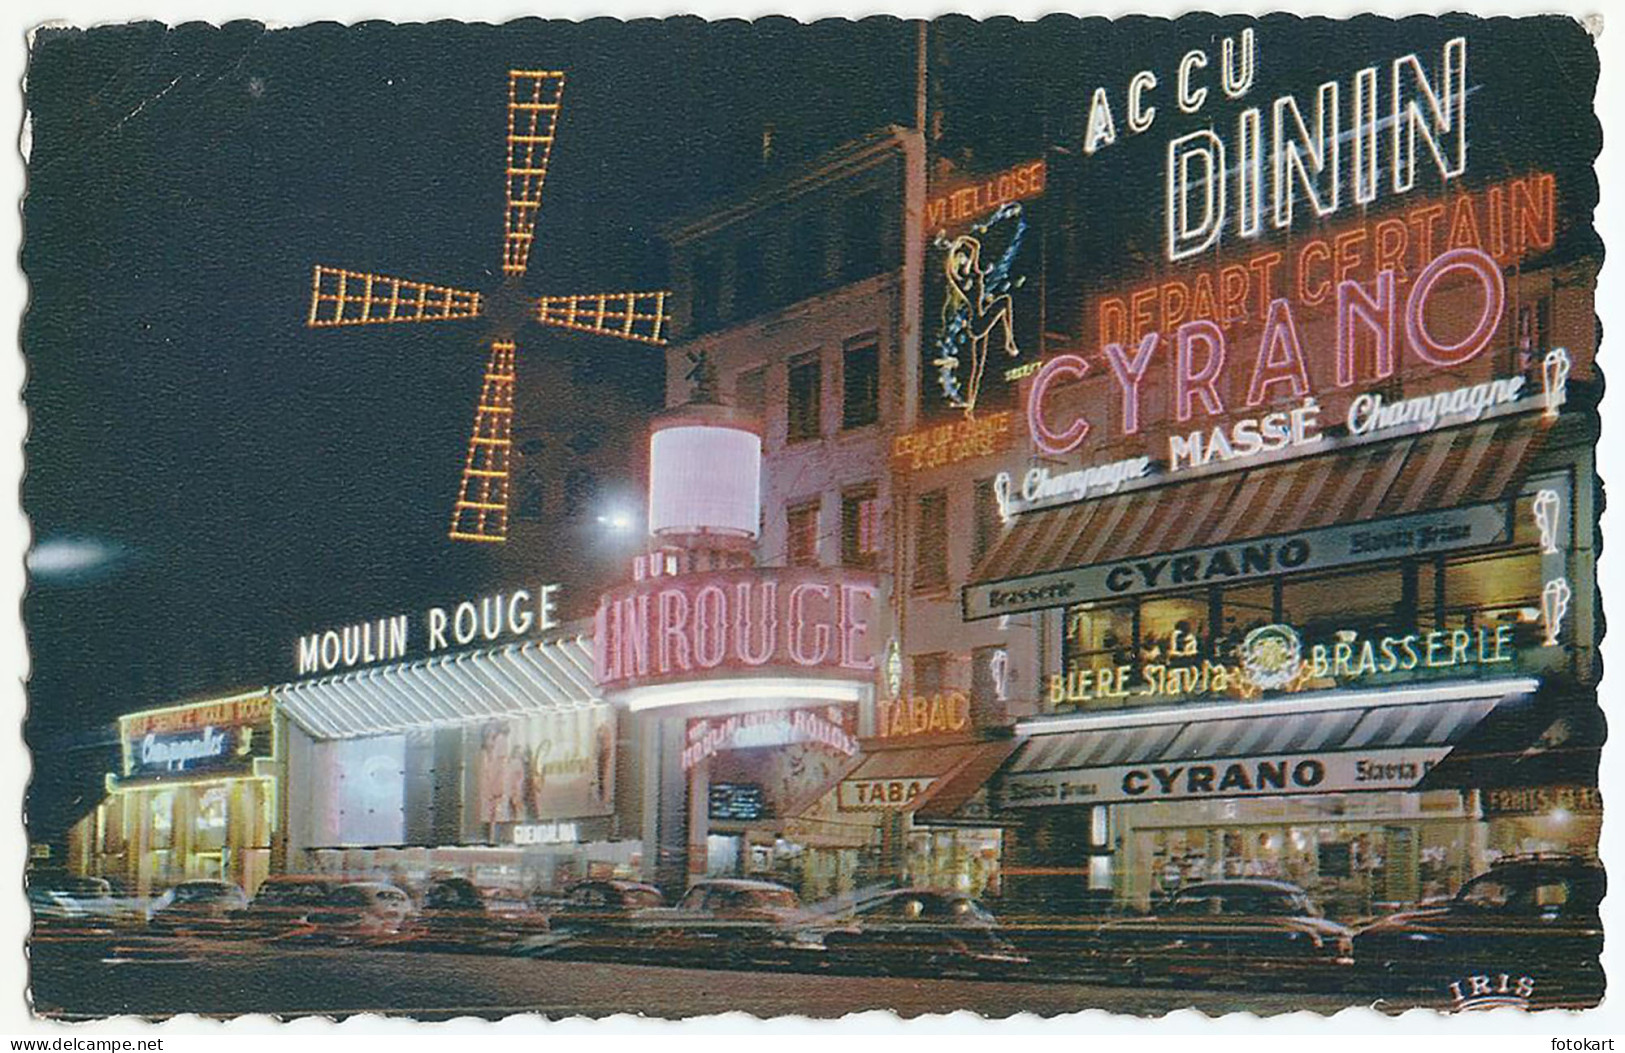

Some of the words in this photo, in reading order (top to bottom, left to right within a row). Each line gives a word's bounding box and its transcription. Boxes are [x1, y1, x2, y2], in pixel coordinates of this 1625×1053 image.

[1083, 28, 1254, 154] ACCU
[1168, 37, 1466, 261] DININ
[1100, 252, 1282, 350] DEPART
[1300, 174, 1555, 305] CERTAIN
[1028, 248, 1505, 454] CYRANO
[1347, 376, 1526, 434] Champagne
[1105, 538, 1311, 593] CYRANO
[299, 614, 407, 675] MOULIN
[429, 583, 559, 651] ROUGE
[658, 582, 877, 674] ROUGE
[1050, 665, 1131, 704] BIERE
[1312, 624, 1513, 678] BRASSERIE
[1169, 629, 1199, 657] La
[878, 692, 967, 738] TABAC
[1121, 758, 1326, 796] CYRANO
[1449, 972, 1535, 1001] IRIS
